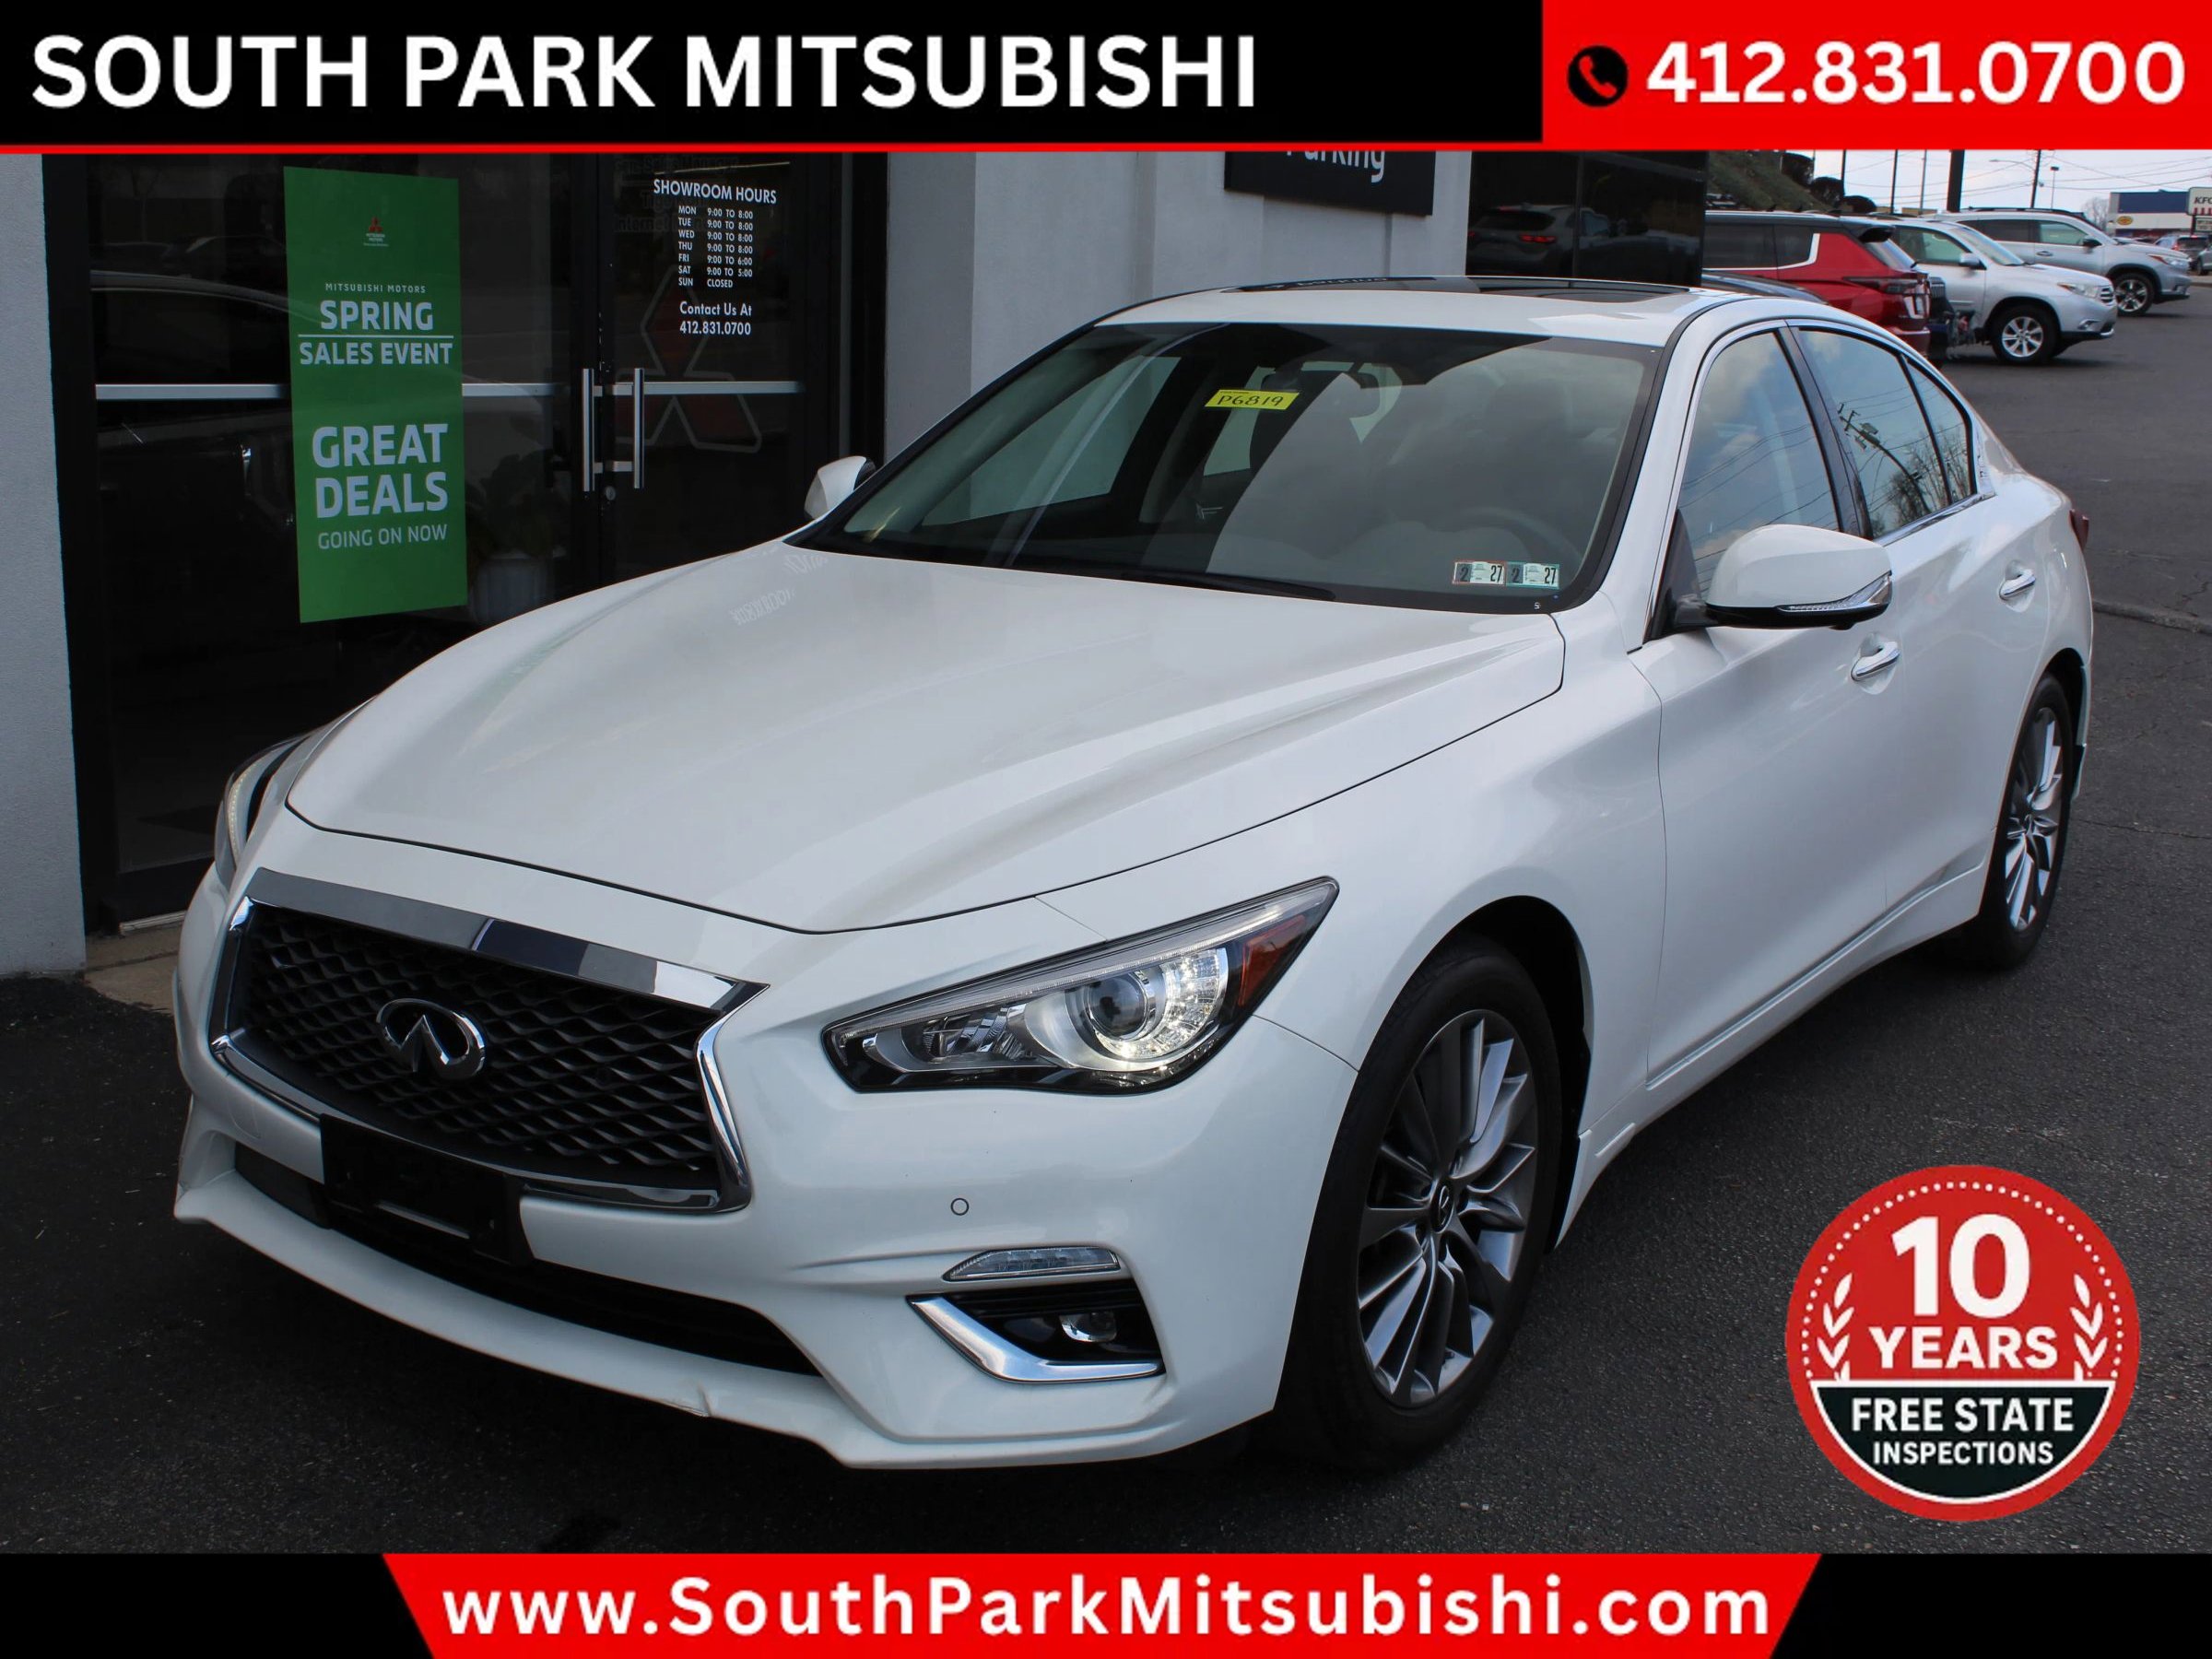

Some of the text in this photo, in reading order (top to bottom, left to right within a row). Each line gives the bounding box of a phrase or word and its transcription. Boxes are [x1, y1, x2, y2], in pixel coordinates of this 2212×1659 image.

[653, 179, 777, 205] SHOWROOM HOURS
[678, 206, 697, 215] MON
[726, 210, 735, 218] TO
[738, 211, 753, 219] 8:00
[678, 218, 691, 226] TUE
[708, 220, 722, 229] 9:00
[725, 221, 734, 229] TO
[738, 222, 753, 230] 8:00
[678, 230, 694, 239] WED
[726, 233, 735, 241] TO
[738, 234, 753, 242] 8:00
[678, 241, 693, 251] THU
[726, 245, 735, 253] TO
[738, 246, 753, 254] 8:00
[678, 253, 689, 262] FRI
[737, 257, 752, 265] 6:00
[678, 265, 752, 277] SAT 9:00 TO 5:00
[325, 283, 426, 293] MITSUBISHI MOTORS
[678, 277, 733, 288] SUN CLOSED
[320, 300, 433, 331] SPRING
[679, 300, 752, 316] Contact Us At
[679, 320, 751, 335] 412.831.0700
[300, 342, 453, 365] SALES EVENT
[1217, 394, 1284, 406] P6819
[312, 423, 448, 468] GREAT
[315, 471, 448, 518] DEALS
[318, 524, 448, 549] GOING ON NOW
[1490, 564, 1503, 582] 27
[1544, 567, 1557, 584] 27
